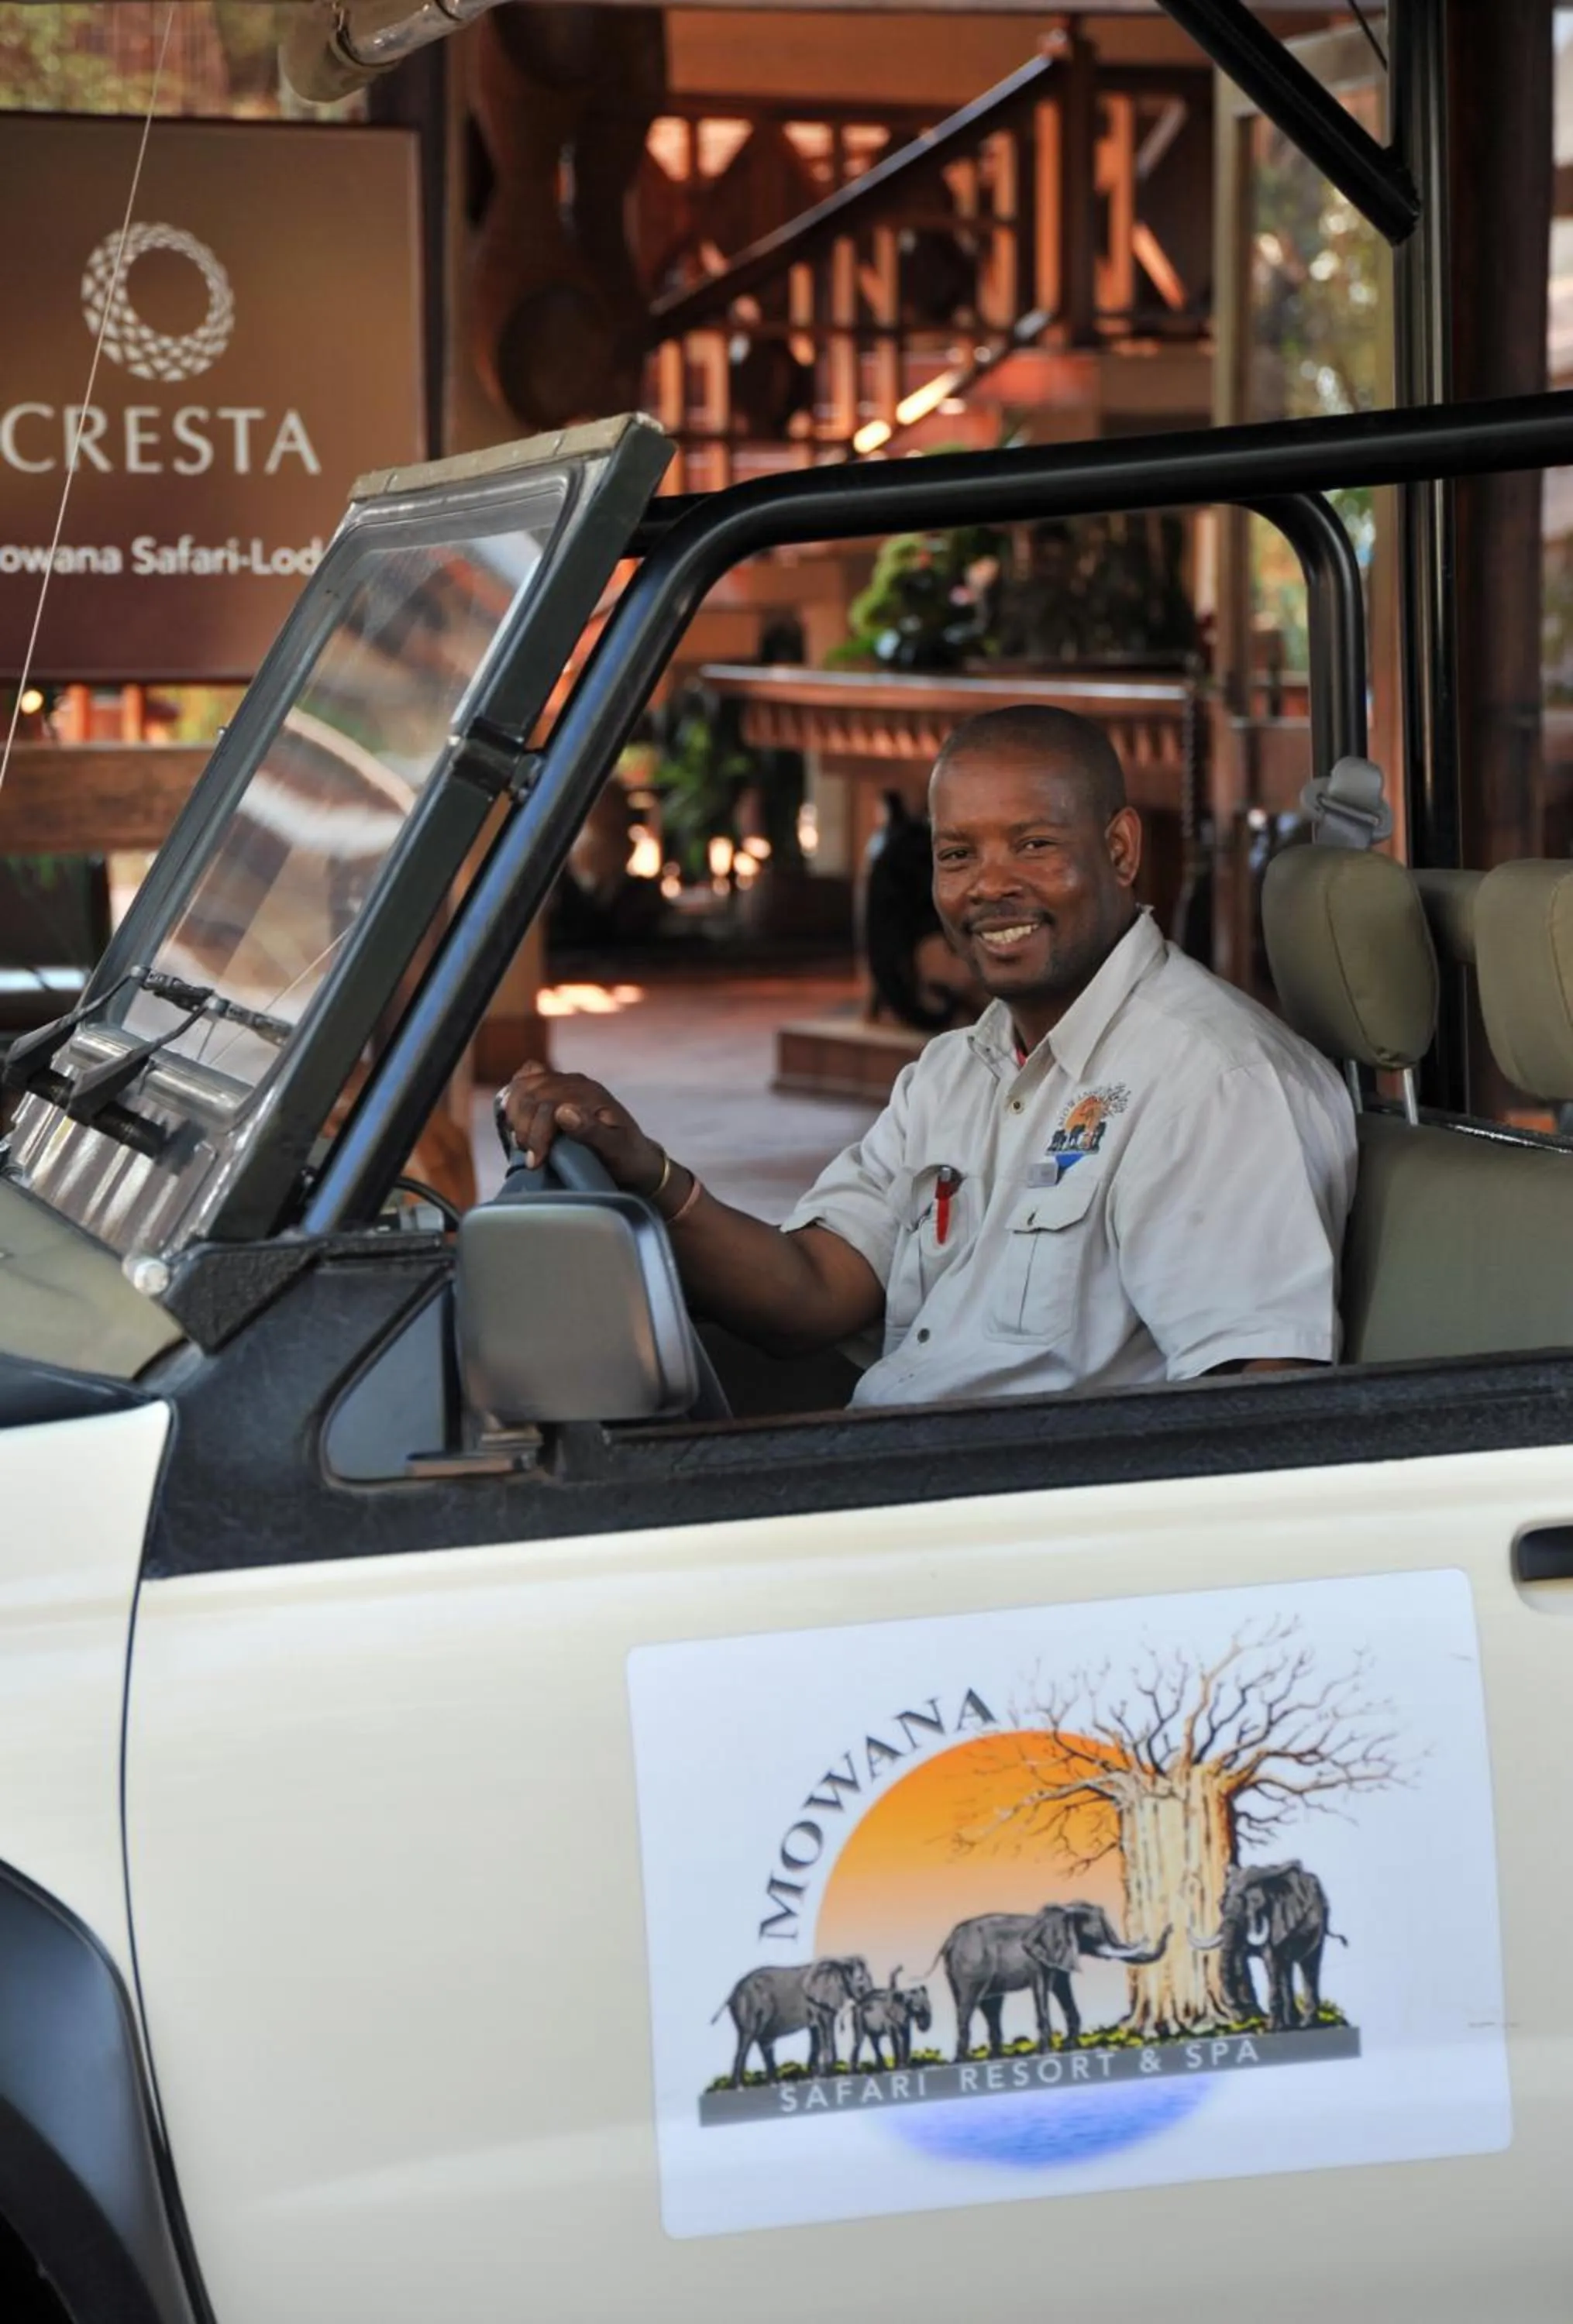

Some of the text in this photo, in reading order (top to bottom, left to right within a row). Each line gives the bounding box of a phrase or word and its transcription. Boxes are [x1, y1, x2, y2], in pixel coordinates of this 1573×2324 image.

[0, 402, 322, 475] CRESTA
[759, 1687, 997, 1943] MOWANA
[780, 2040, 1259, 2113] SAFARI RESORT & SPA
